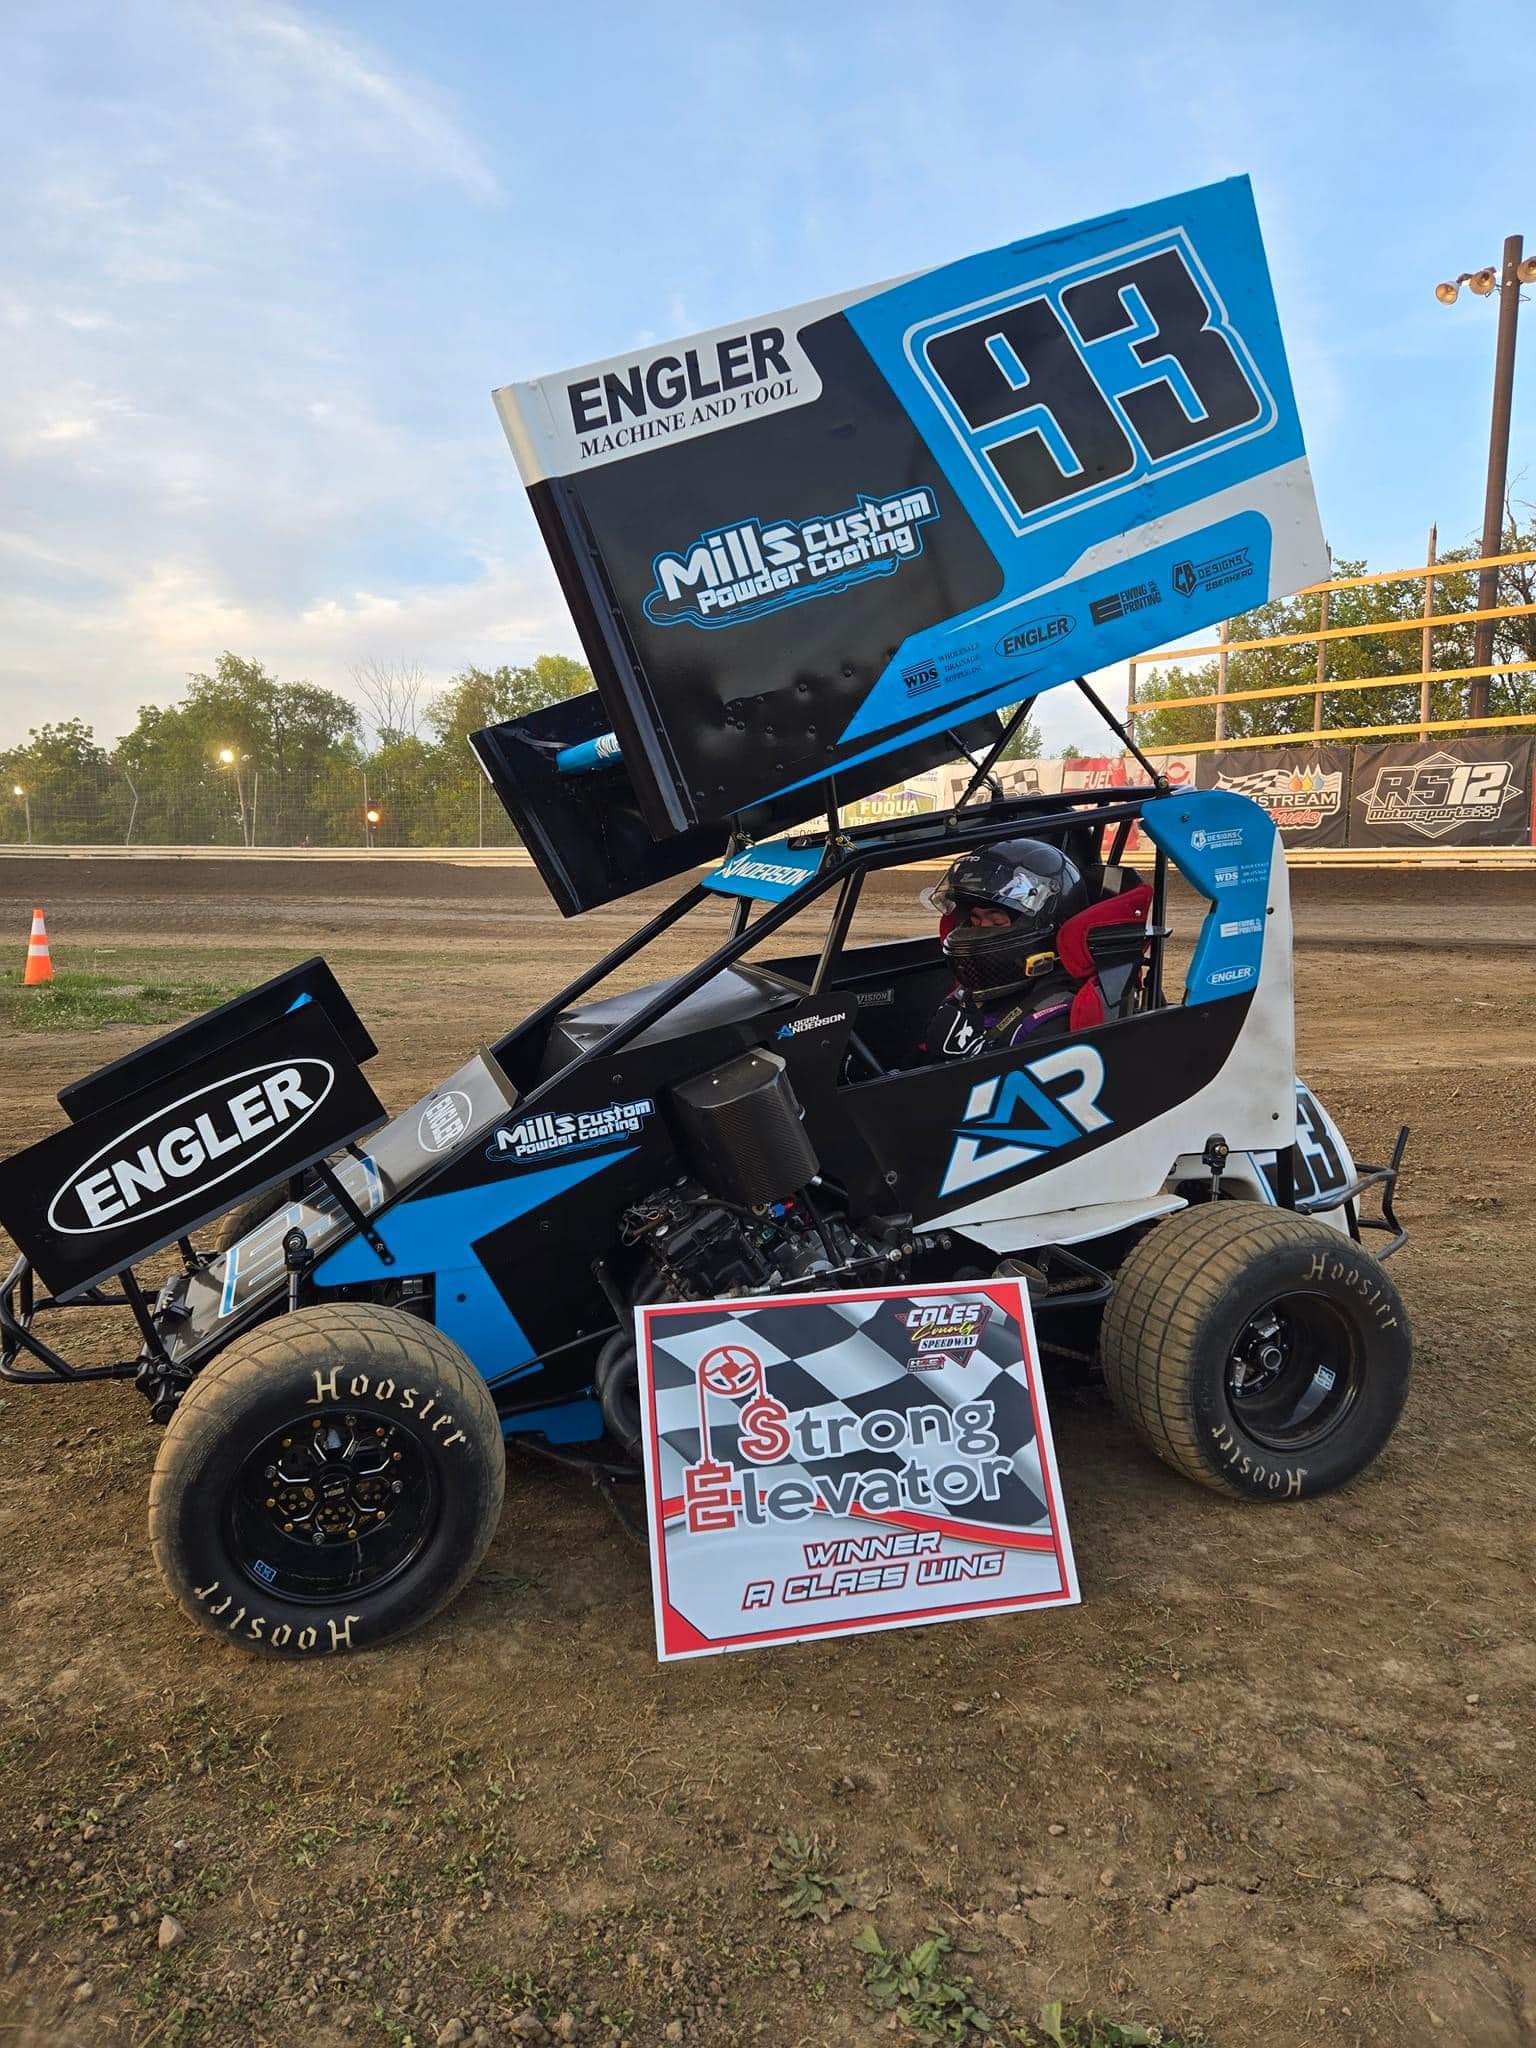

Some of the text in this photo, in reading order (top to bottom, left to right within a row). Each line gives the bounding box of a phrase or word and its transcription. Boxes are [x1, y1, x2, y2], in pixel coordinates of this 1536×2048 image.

[567, 326, 793, 435] ENGLER
[924, 245, 1263, 518] 93
[580, 379, 799, 459] MACHINE AND TOOL
[658, 525, 801, 602] Mills
[1199, 554, 1244, 579] DESIGNS
[696, 563, 806, 615] Powder
[1119, 584, 1148, 603] EWING
[1122, 591, 1162, 615] PRINTING
[1003, 617, 1070, 657] ENGLER
[903, 667, 939, 689] WDS
[1083, 770, 1112, 789] FUEL
[1369, 762, 1513, 809] RS12
[861, 800, 919, 816] FUQUA
[1369, 806, 1473, 824] Motorsports
[714, 853, 816, 886] ANDERSON
[1215, 872, 1239, 882] WDS
[1211, 967, 1251, 983] ENGLER
[776, 1012, 846, 1040] ANDERSON
[788, 1014, 820, 1029] LOGAN
[425, 1095, 465, 1150] ENGLER
[496, 1115, 577, 1150] Mills
[75, 1067, 315, 1227] ENGLER
[515, 1133, 578, 1157] Powder
[1303, 1251, 1398, 1330] Hoosier
[906, 1304, 982, 1328] COLES
[911, 1321, 976, 1341] County
[920, 1336, 976, 1350] SPEEDWAY
[305, 1365, 467, 1447] Hoosier
[739, 1400, 998, 1461] Strong
[1212, 1424, 1308, 1497] Hoosier
[686, 1457, 1012, 1533] Elevator
[804, 1531, 941, 1568] WINNER
[741, 1551, 1005, 1610] A CLASS WING
[194, 1582, 360, 1650] Hoosier
